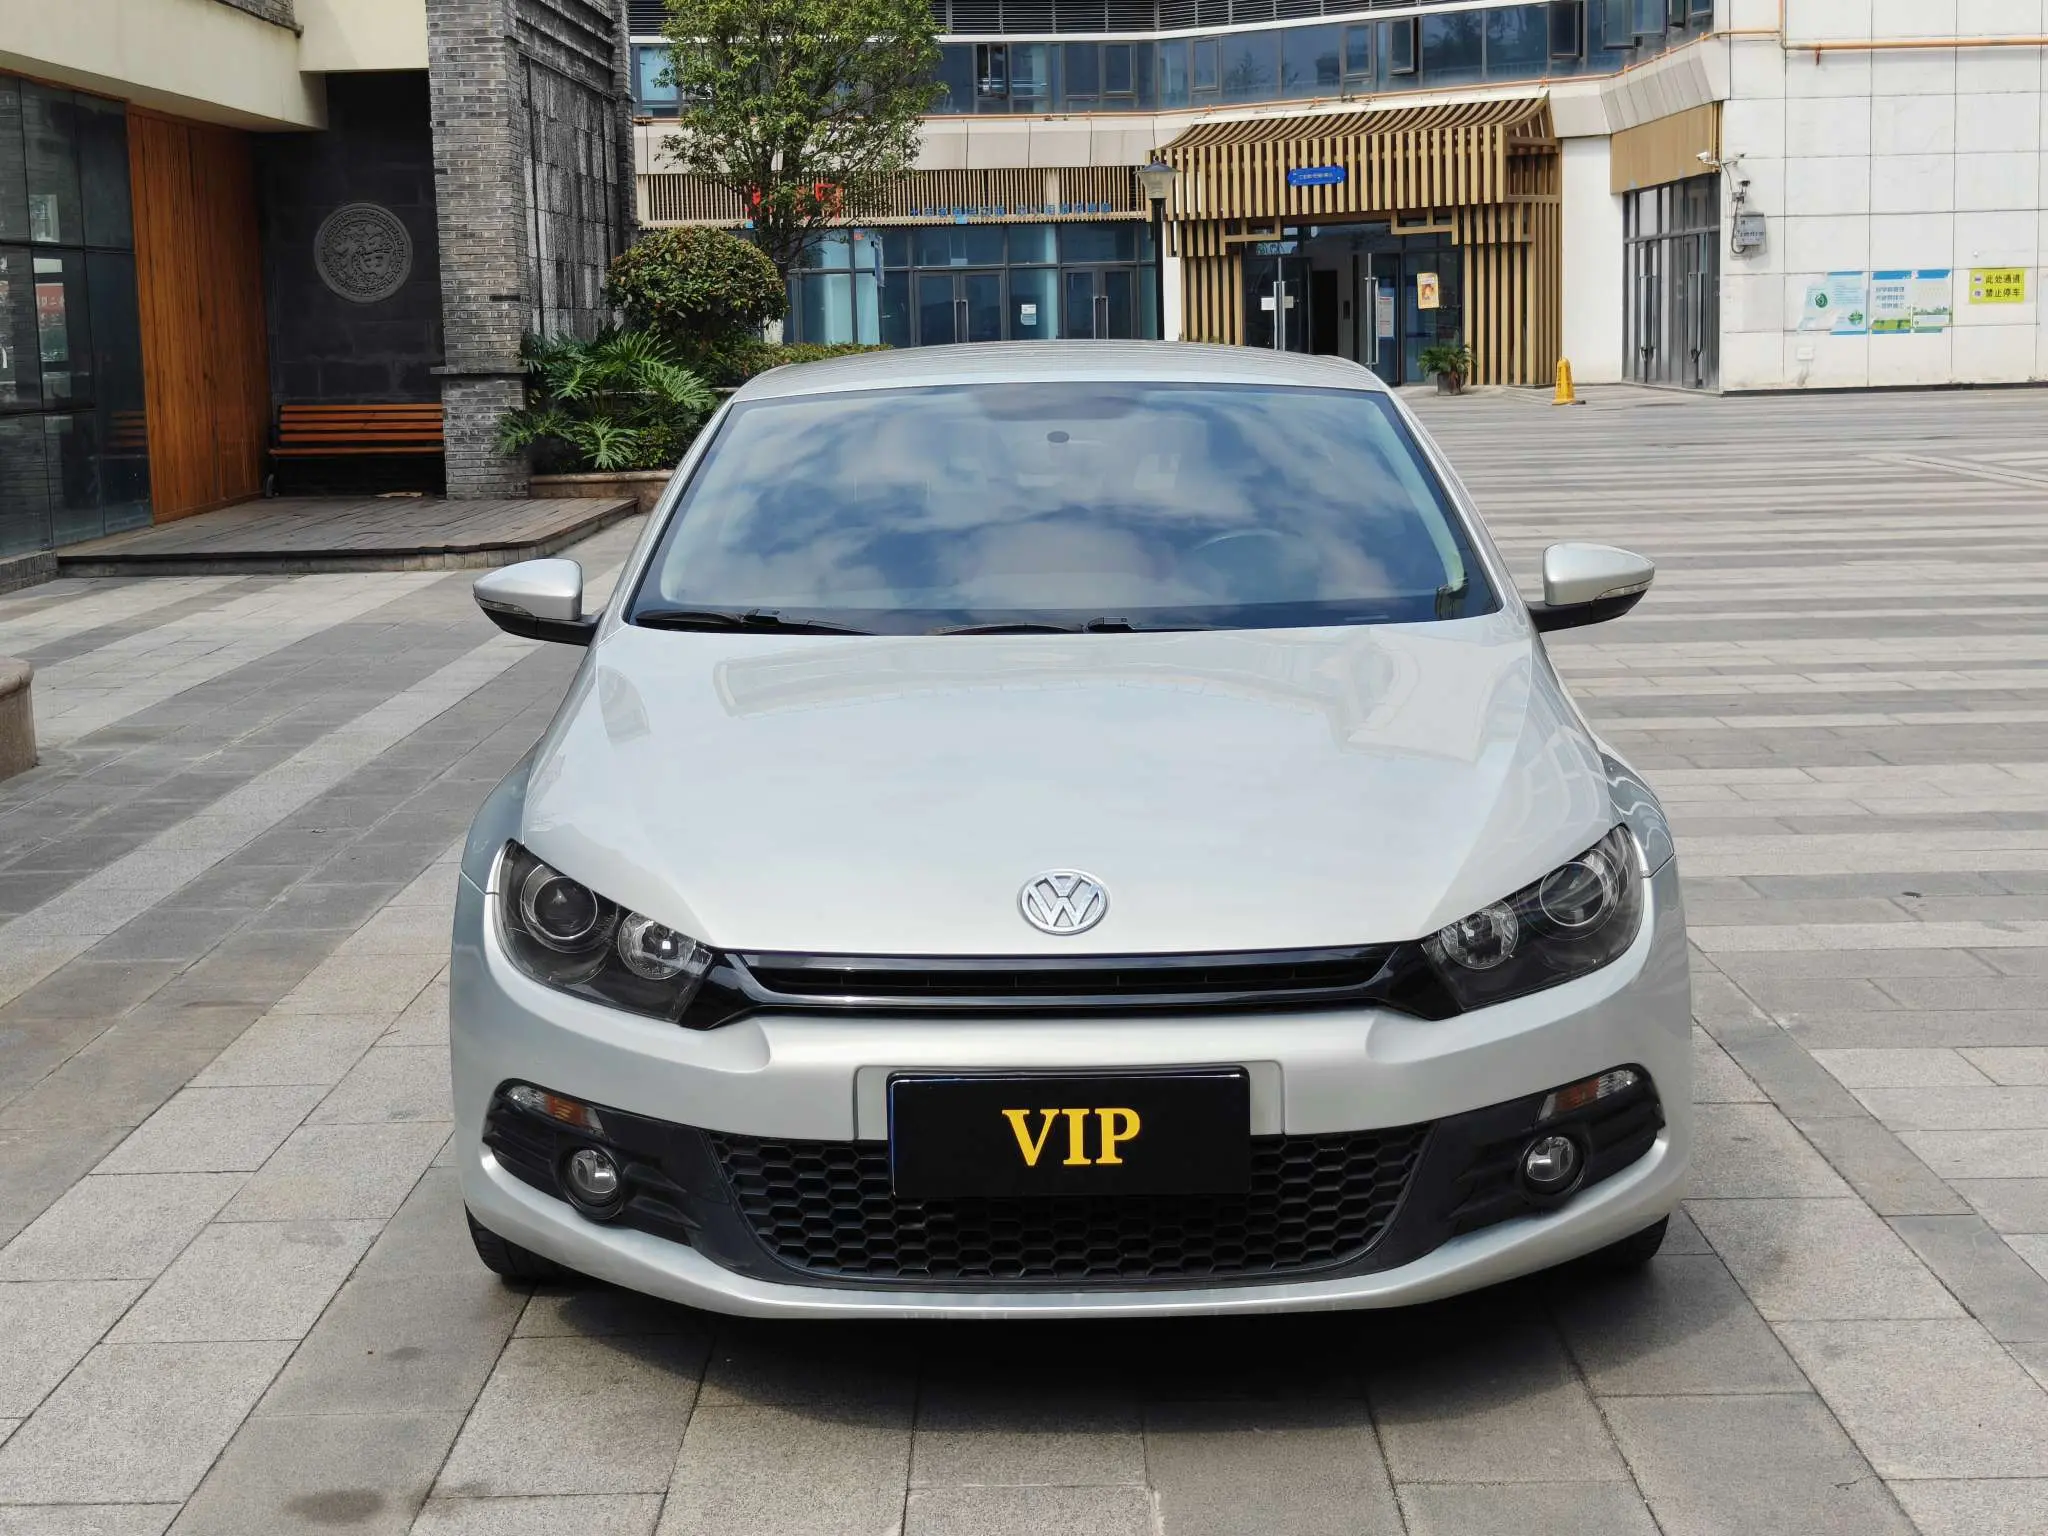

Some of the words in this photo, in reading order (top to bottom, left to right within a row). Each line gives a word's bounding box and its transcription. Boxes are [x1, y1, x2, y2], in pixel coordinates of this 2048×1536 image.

[1985, 273, 2021, 285] 此处通道
[1985, 287, 2021, 298] 禁止停车
[1023, 872, 1105, 931] VW
[1001, 1107, 1141, 1166] VIP
